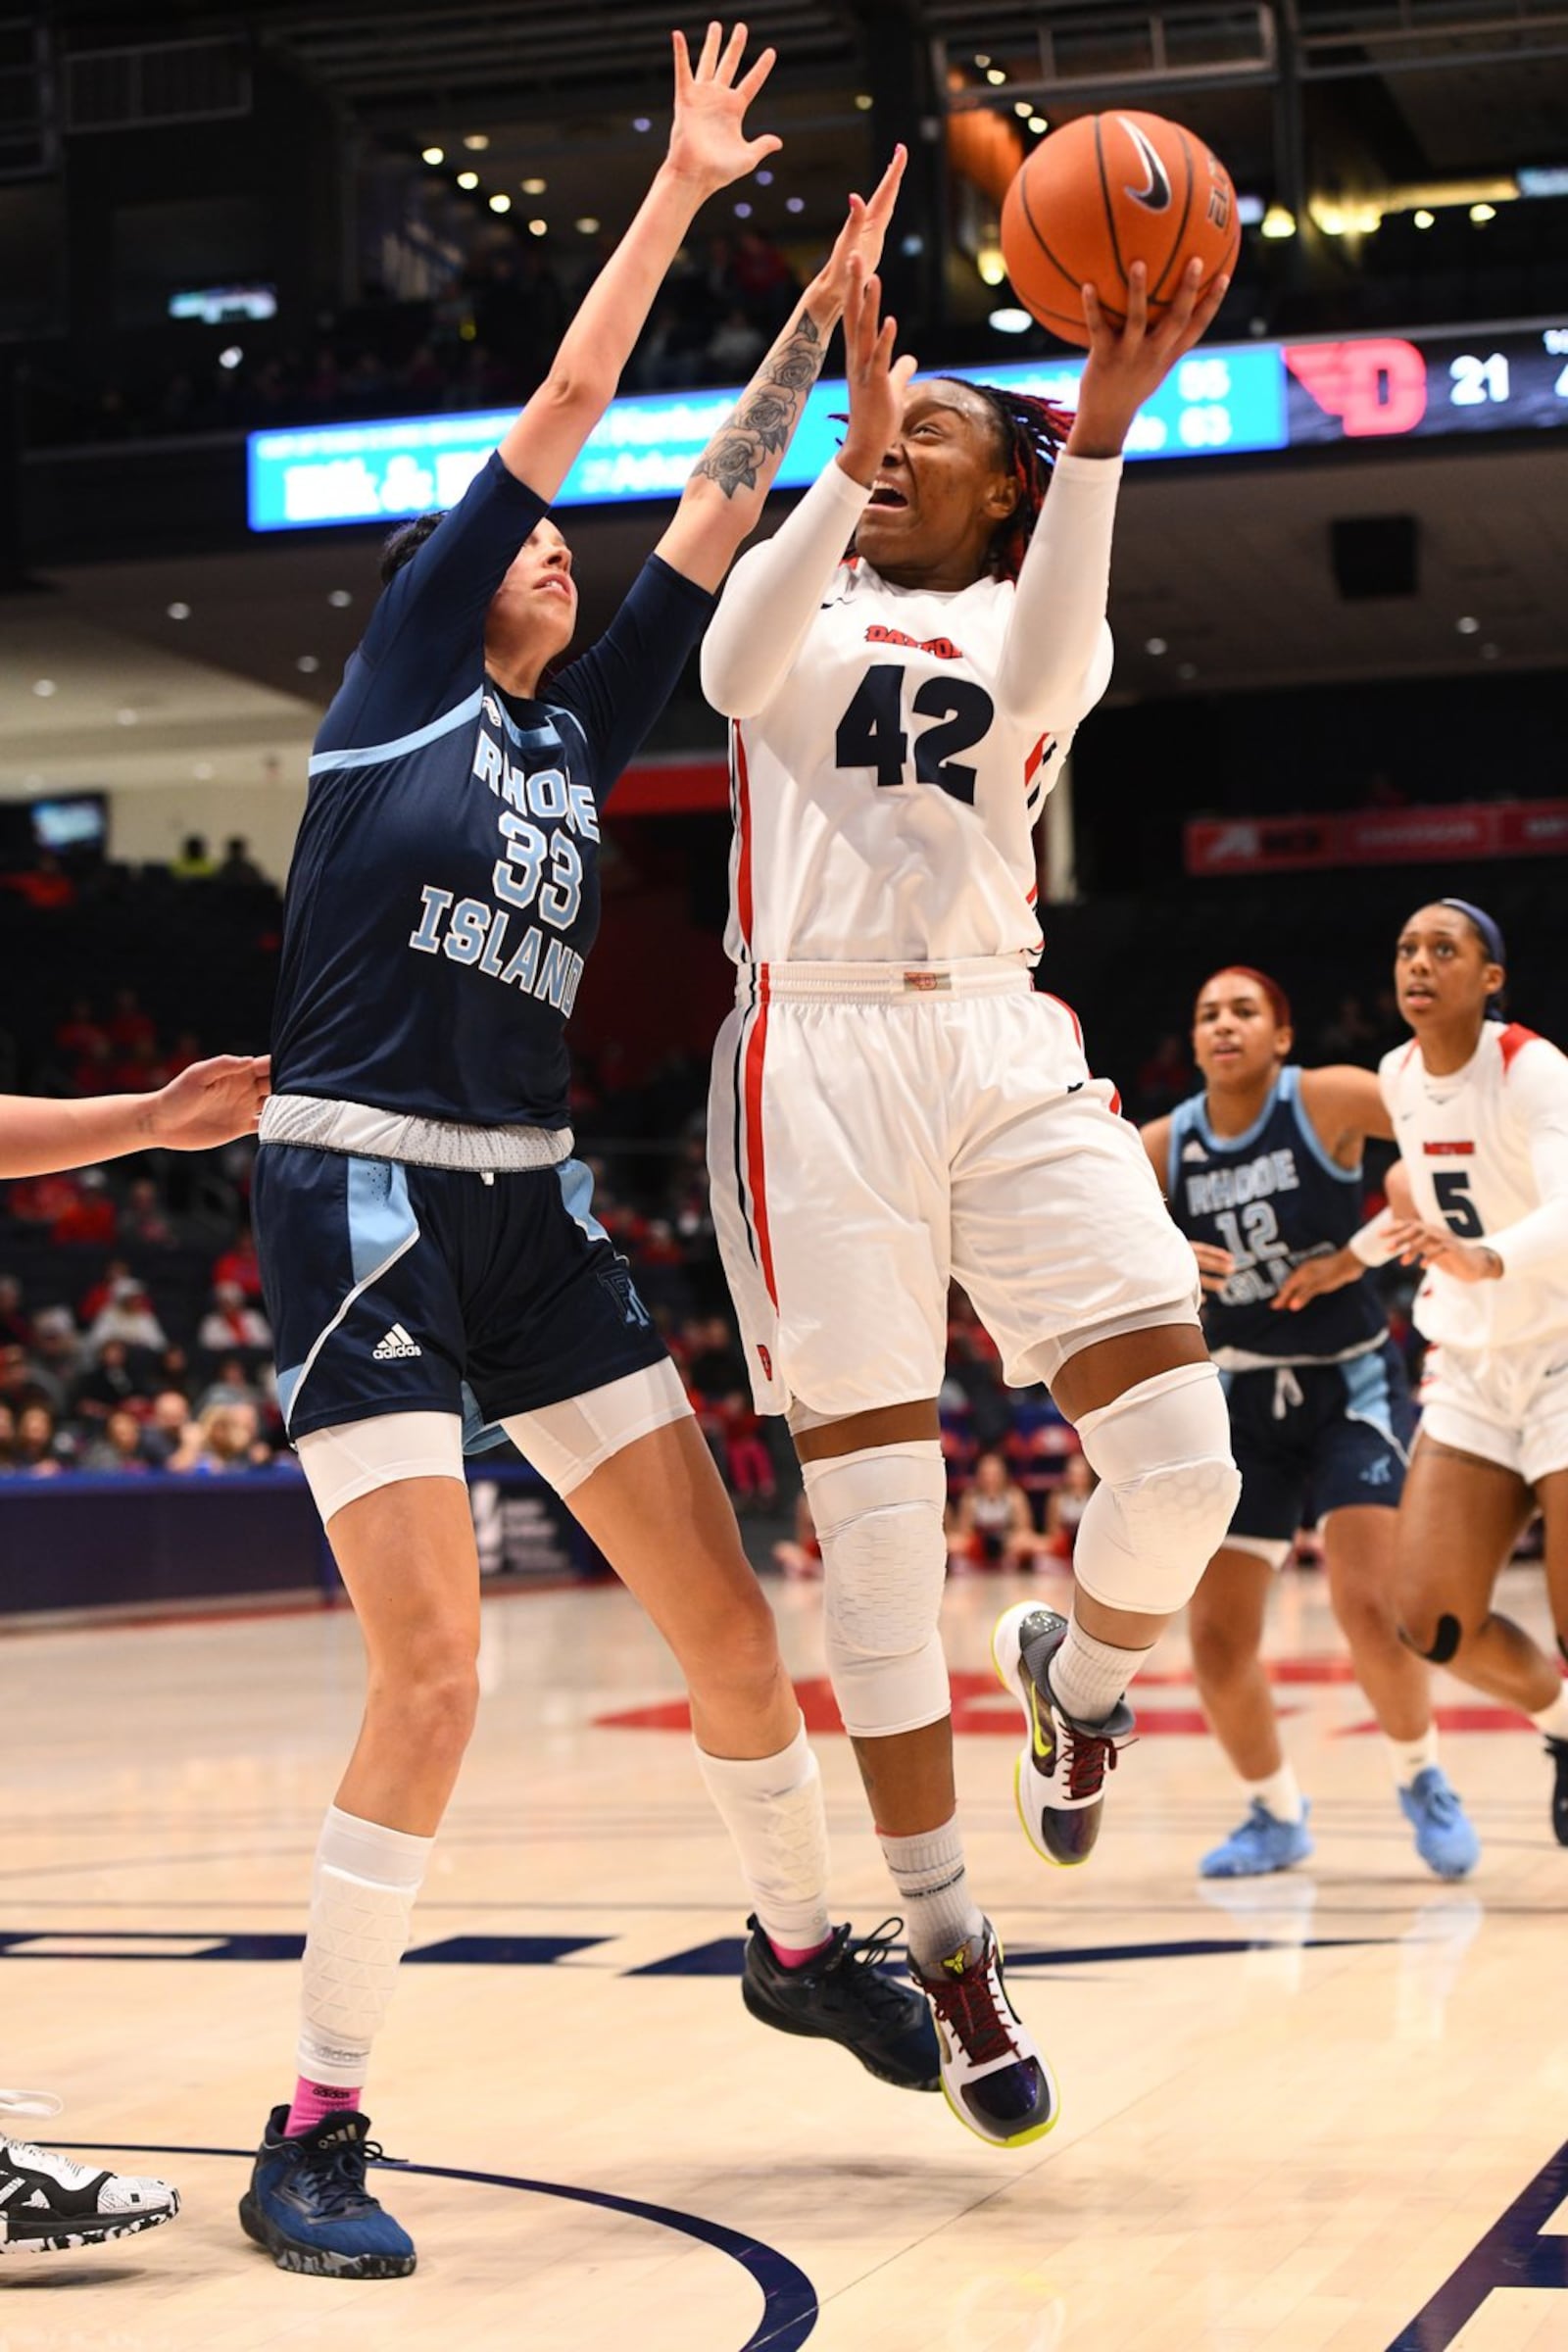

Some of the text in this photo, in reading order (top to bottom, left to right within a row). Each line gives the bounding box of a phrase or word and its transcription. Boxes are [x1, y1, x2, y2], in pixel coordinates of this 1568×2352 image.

[1448, 353, 1510, 406] 21
[836, 664, 994, 806] 42
[472, 729, 601, 844] RHOE
[492, 811, 584, 931] 33
[409, 885, 585, 1019] ISLAND
[1186, 1148, 1300, 1216] RHODE
[1432, 1171, 1485, 1238] 5
[1215, 1200, 1290, 1271] 12
[372, 1345, 422, 1360] adidas
